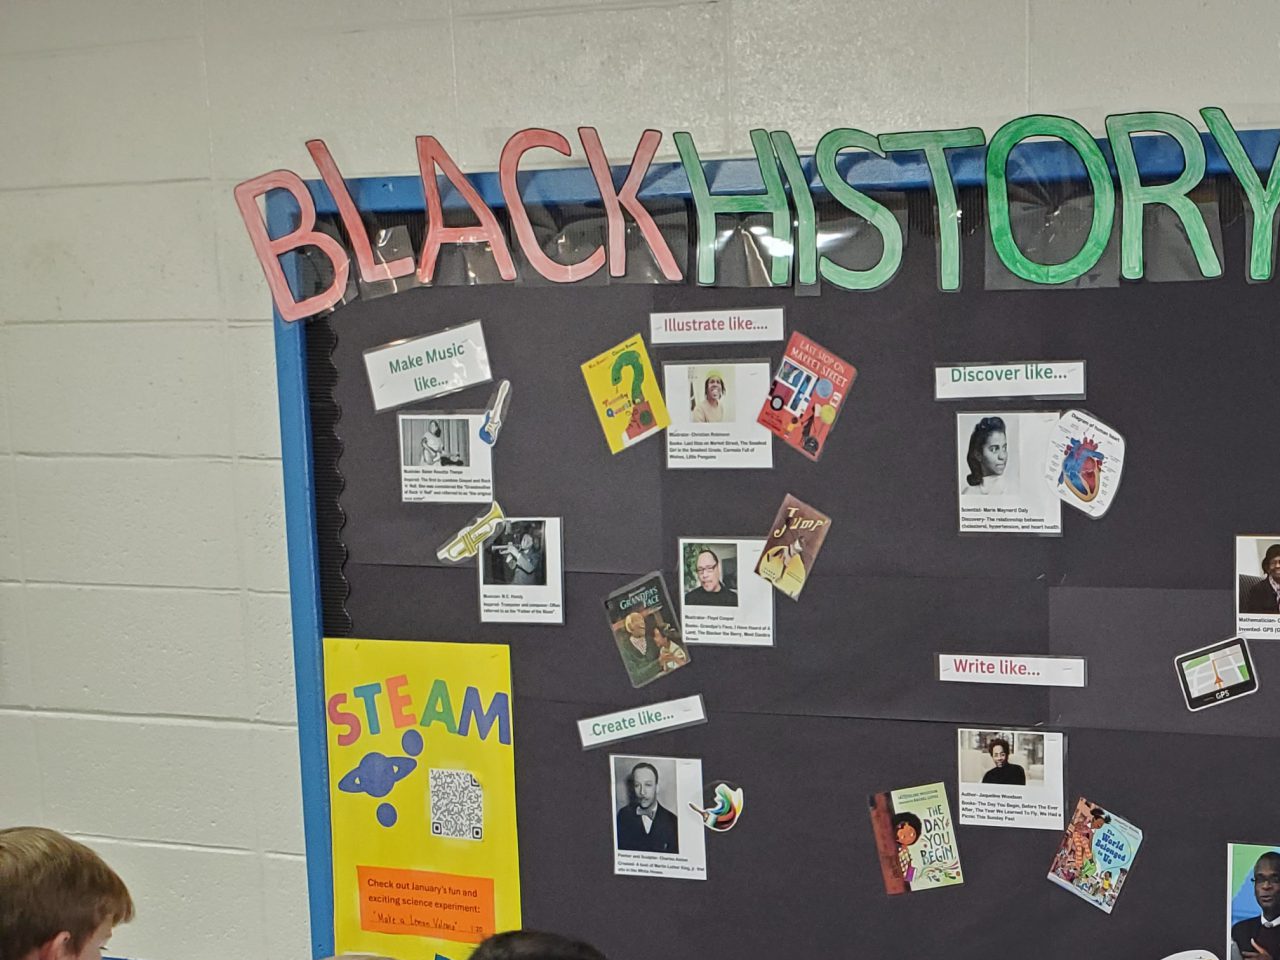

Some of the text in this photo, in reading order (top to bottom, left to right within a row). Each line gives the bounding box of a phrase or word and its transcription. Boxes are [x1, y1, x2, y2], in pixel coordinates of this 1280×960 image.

[234, 126, 683, 323] BLACK
[665, 318, 724, 332] Illustrate
[389, 343, 464, 374] Make Music
[800, 341, 844, 373] LAST STOP ON
[792, 347, 847, 387] MARKET STREET
[951, 364, 1067, 382] Discover like...
[414, 376, 448, 391] like...
[954, 659, 1040, 676] Write like...
[1216, 690, 1229, 699] GPS
[327, 674, 511, 746] STEAM
[592, 710, 674, 736] Create like...
[927, 805, 944, 817] THE
[924, 816, 945, 833] DAY
[924, 832, 949, 849] YOU
[1102, 833, 1124, 851] World
[1095, 839, 1126, 861] Belonged
[1103, 853, 1112, 864] Us
[368, 879, 393, 888] Check
[448, 887, 460, 895] fun
[369, 895, 480, 913] exciting science experiment:
